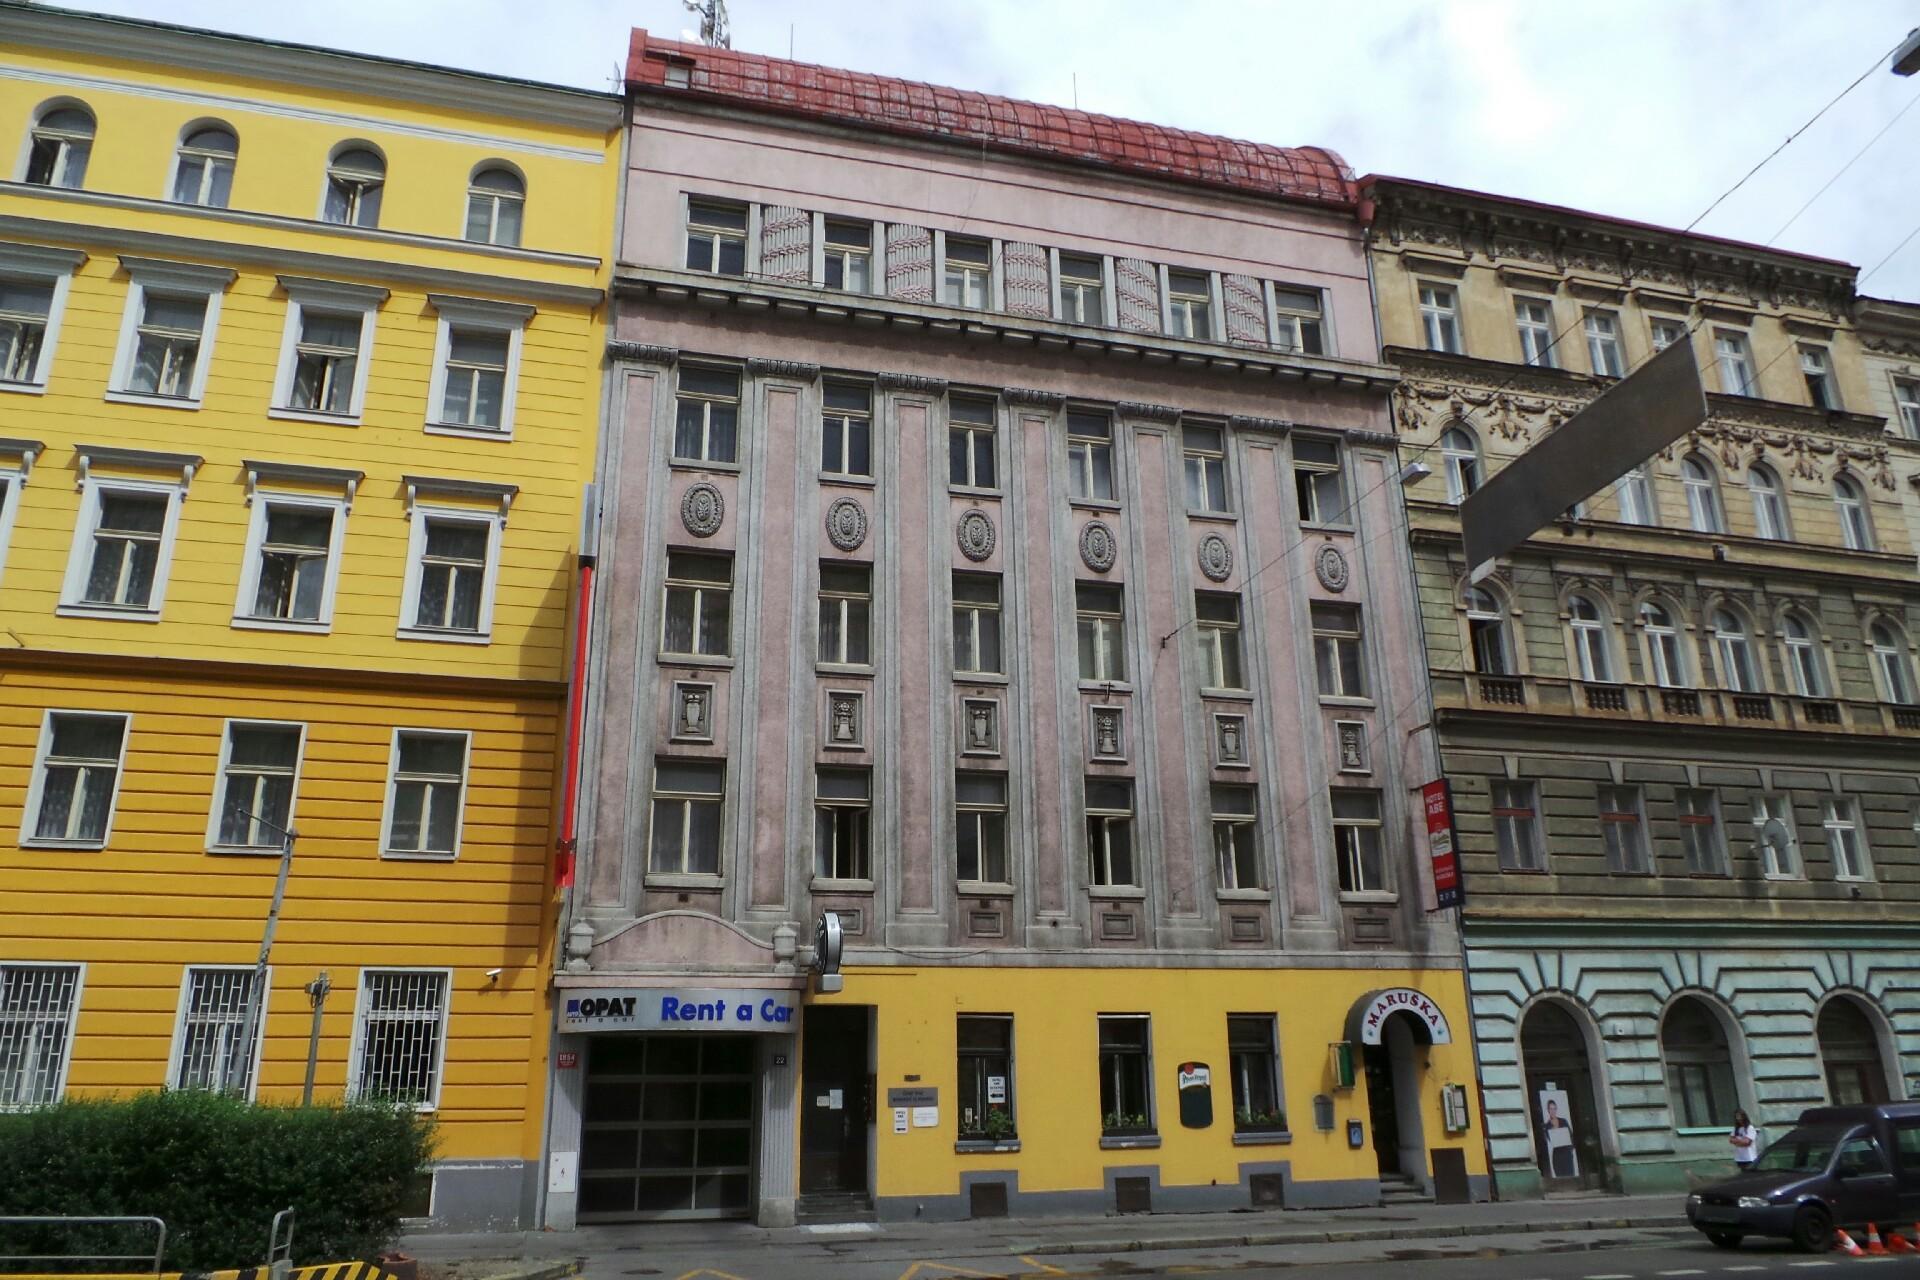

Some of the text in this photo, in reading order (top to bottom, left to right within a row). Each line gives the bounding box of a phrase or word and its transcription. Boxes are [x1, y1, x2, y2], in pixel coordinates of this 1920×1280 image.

[580, 997, 637, 1017] OPAT
[661, 996, 794, 1023] Rent a Car
[776, 1056, 785, 1064] 22
